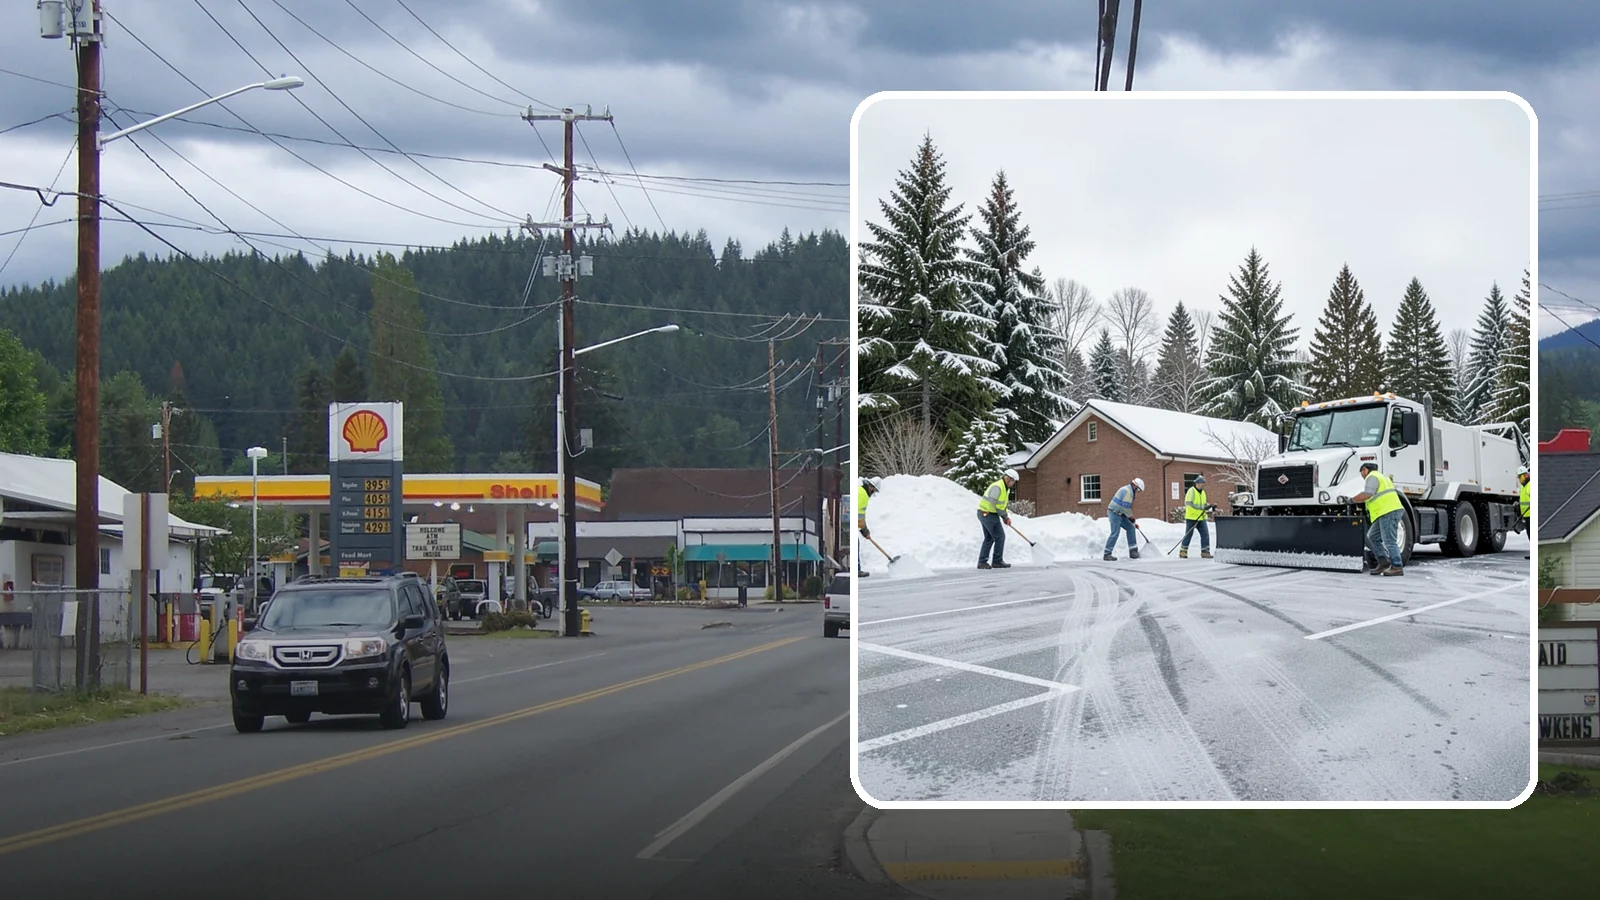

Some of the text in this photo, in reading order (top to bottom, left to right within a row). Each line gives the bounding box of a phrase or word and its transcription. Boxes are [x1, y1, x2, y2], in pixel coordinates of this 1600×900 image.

[365, 480, 383, 490] 395
[490, 484, 547, 499] Shell
[365, 494, 383, 504] 405
[365, 508, 383, 518] 415
[365, 522, 383, 533] 429
